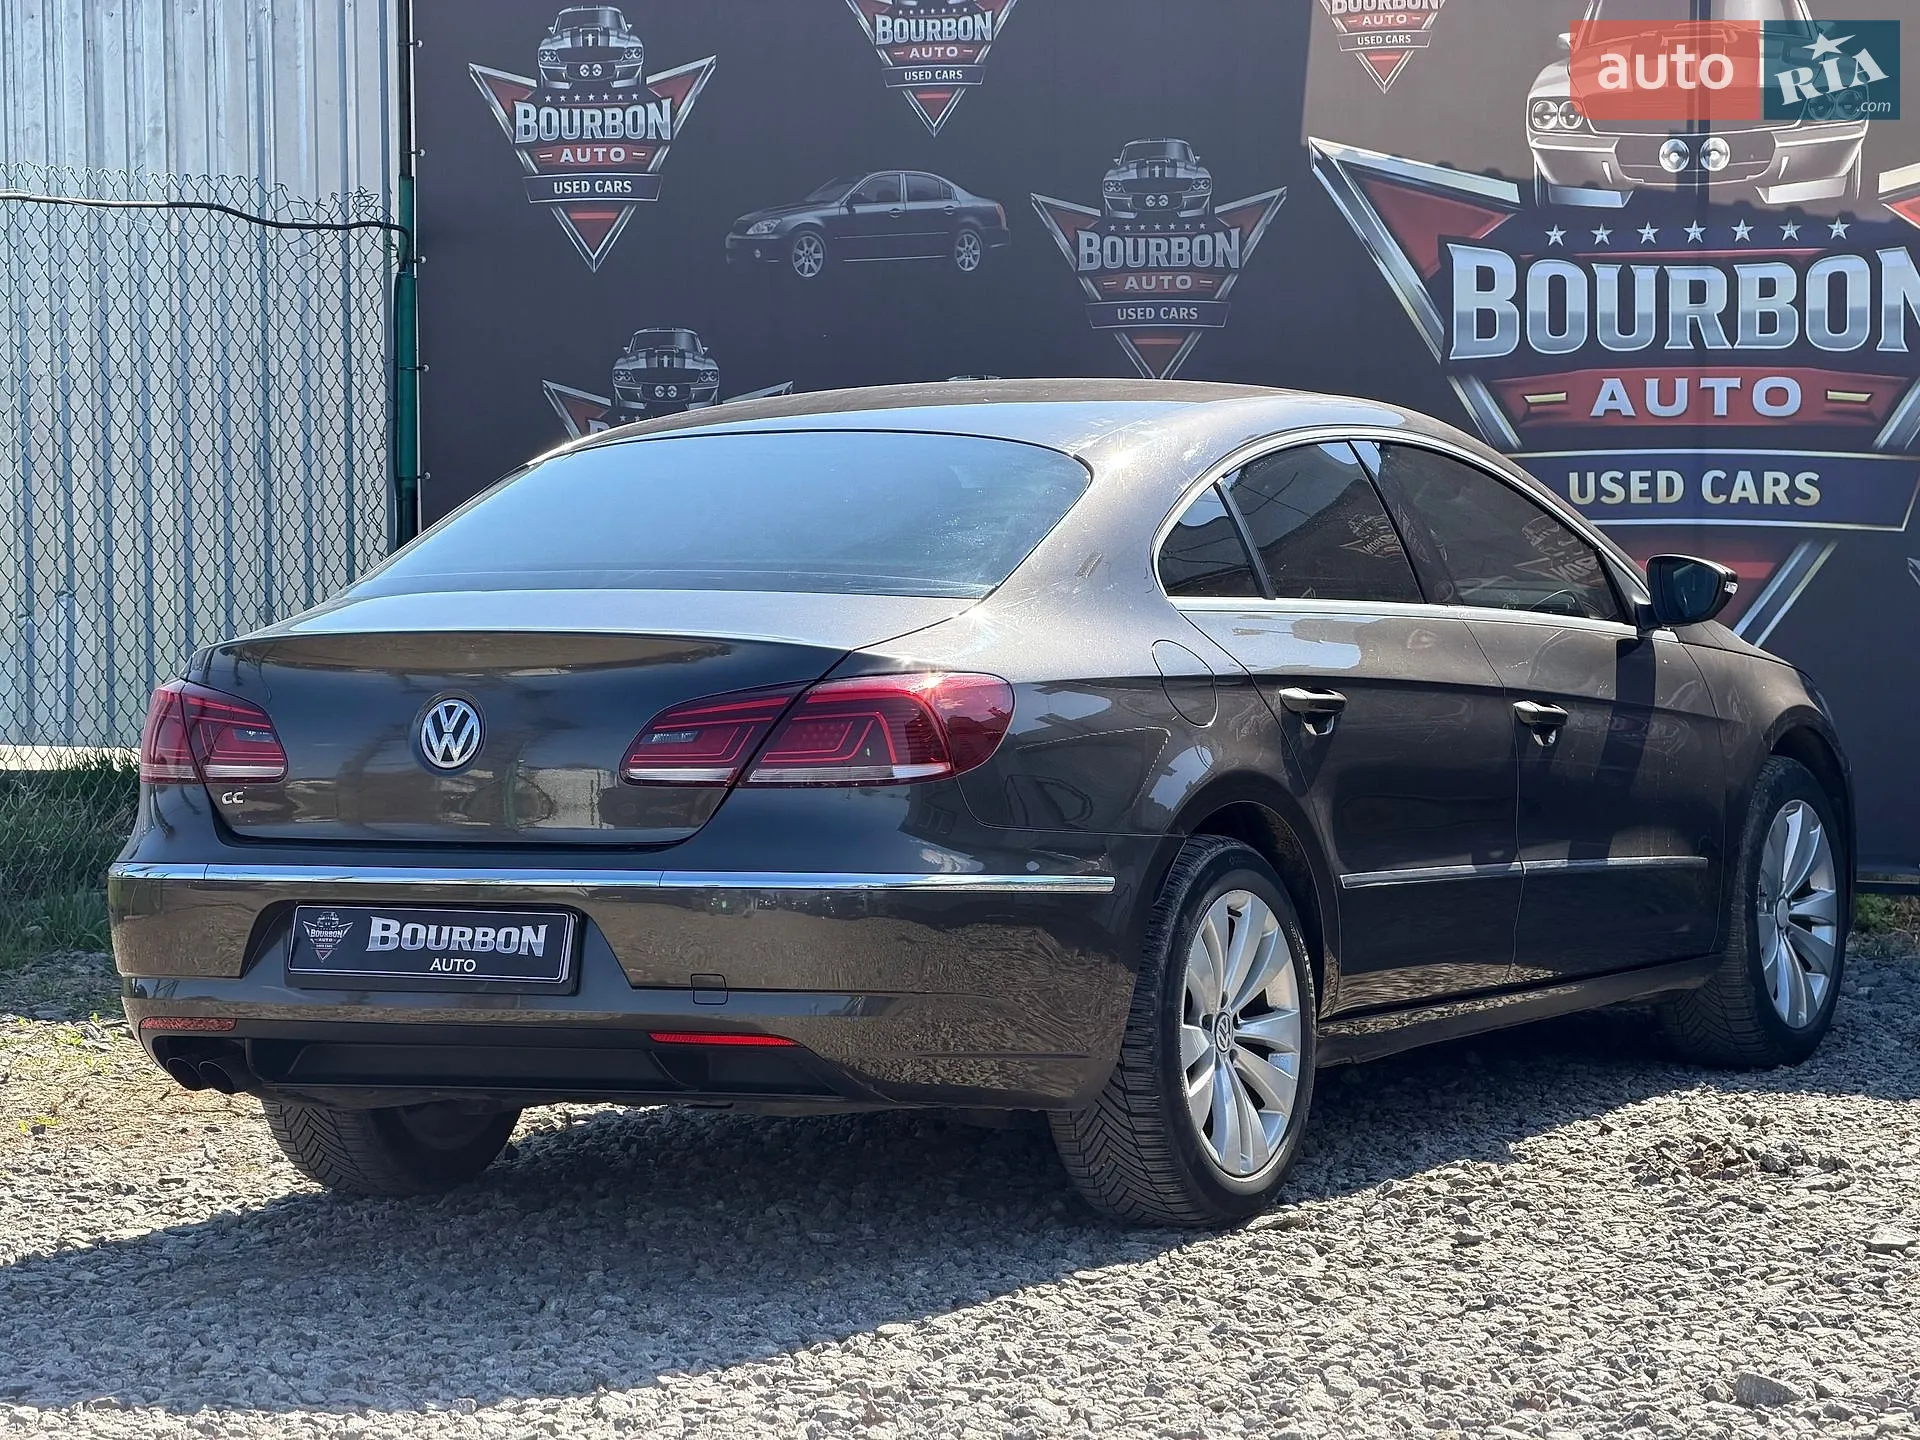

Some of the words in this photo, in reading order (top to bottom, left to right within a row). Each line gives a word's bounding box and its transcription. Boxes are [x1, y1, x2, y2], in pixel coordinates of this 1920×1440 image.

[1362, 14, 1407, 25] AUTO
[875, 10, 993, 45] BOURBON
[1357, 36, 1382, 45] USED
[1385, 34, 1412, 44] CARS
[909, 46, 958, 58] AUTO
[904, 70, 932, 81] USED
[935, 69, 963, 80] CARS
[514, 98, 673, 143] BOURBON
[559, 147, 626, 163] AUTO
[553, 181, 591, 194] USED
[595, 180, 632, 193] CARS
[1077, 228, 1241, 271] BOURBON
[1124, 275, 1192, 290] AUTO
[1446, 243, 1920, 360] BOURBON
[1117, 307, 1155, 320] USED
[1160, 307, 1198, 320] CARS
[1590, 376, 1802, 417] AUTO
[1568, 470, 1684, 505] USED
[1701, 469, 1821, 506] CARS
[221, 791, 244, 805] CC
[310, 929, 343, 938] BOURBON
[365, 915, 549, 957] BOURBON
[429, 958, 476, 973] AUTO
